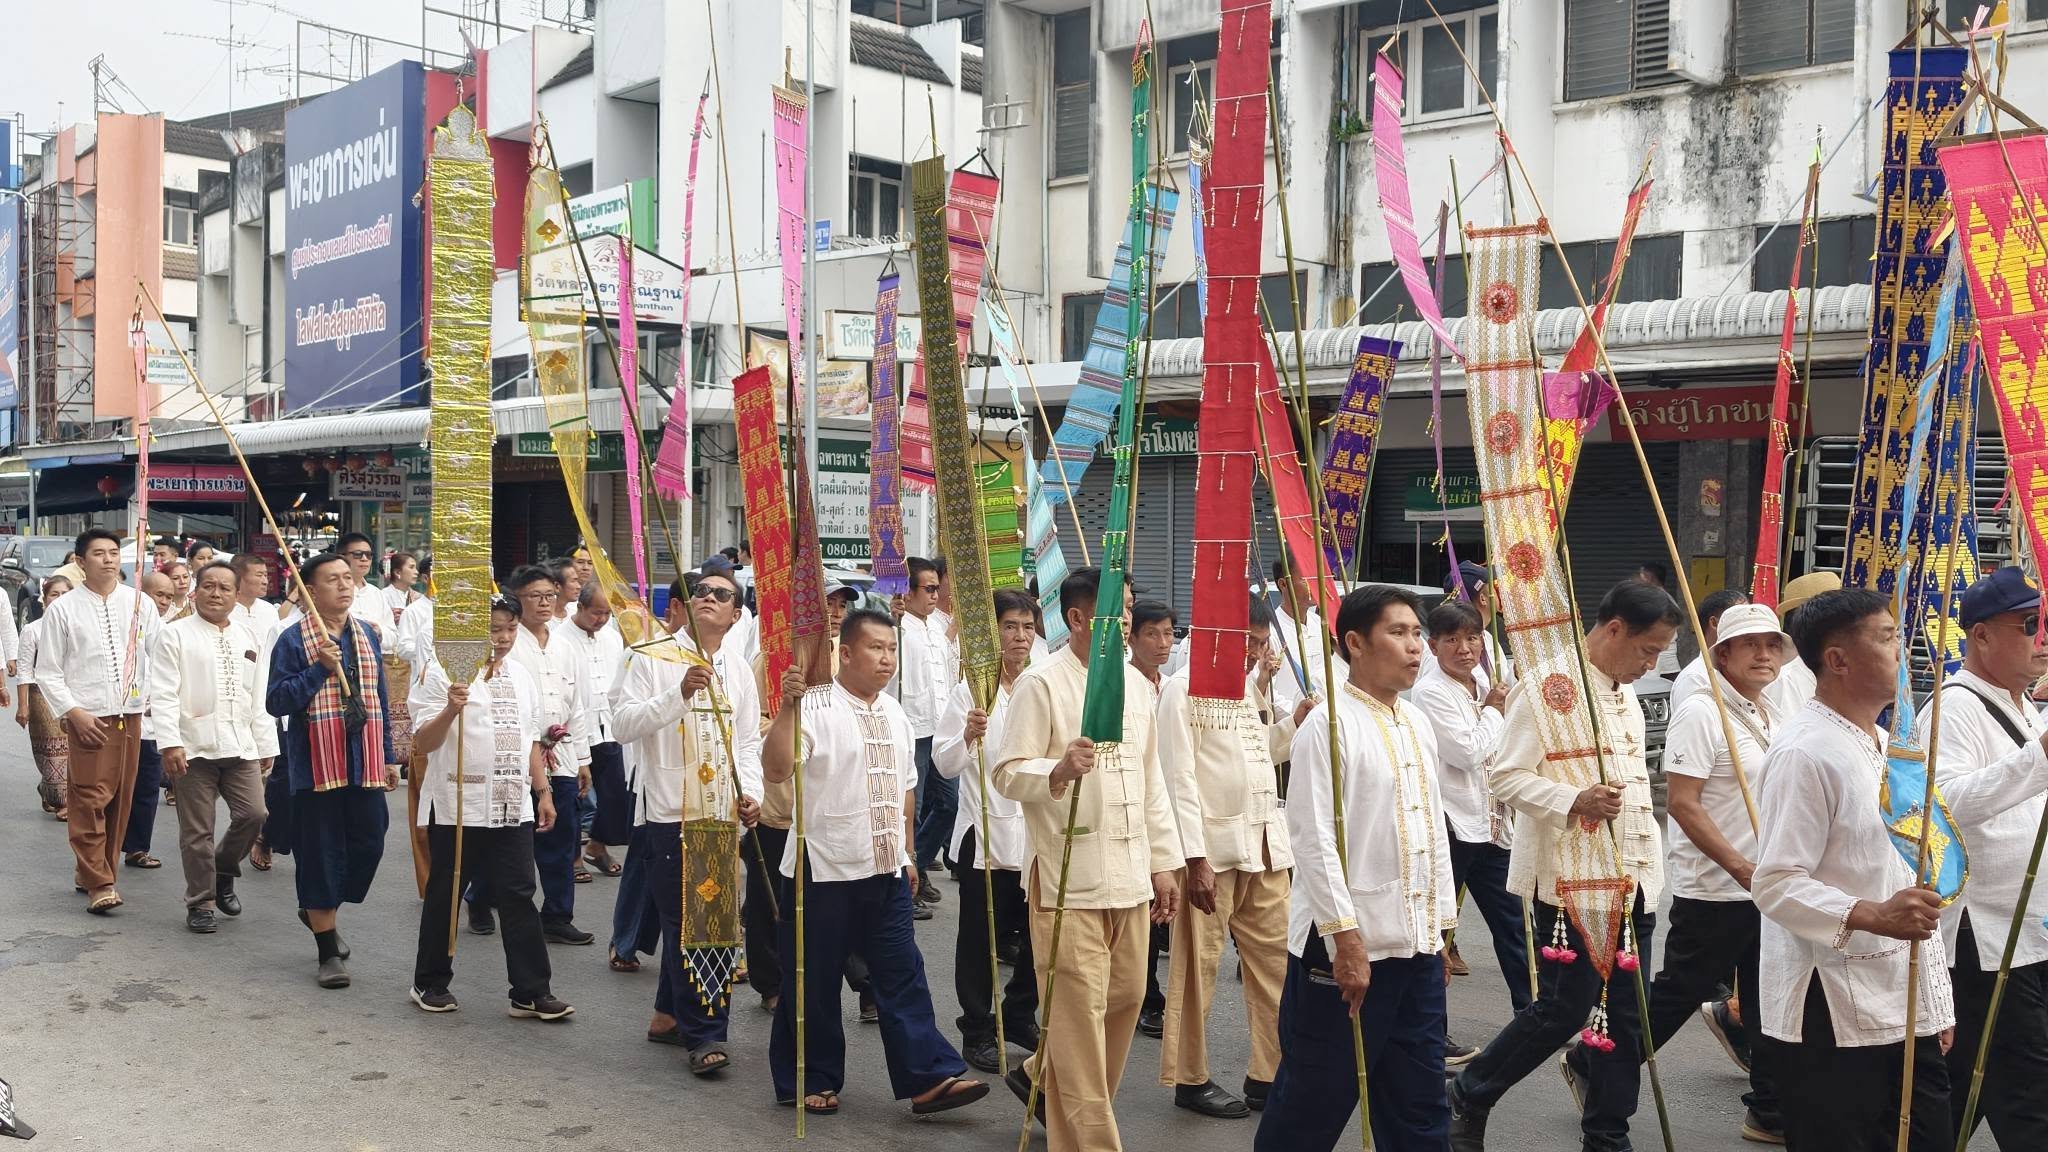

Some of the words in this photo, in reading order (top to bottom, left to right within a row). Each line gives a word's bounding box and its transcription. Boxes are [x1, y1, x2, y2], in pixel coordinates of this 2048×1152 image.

[289, 107, 398, 210] พะเยาการแว่น
[855, 505, 868, 517] 16.
[854, 525, 867, 535] 9.0
[827, 543, 870, 557] 080-013
